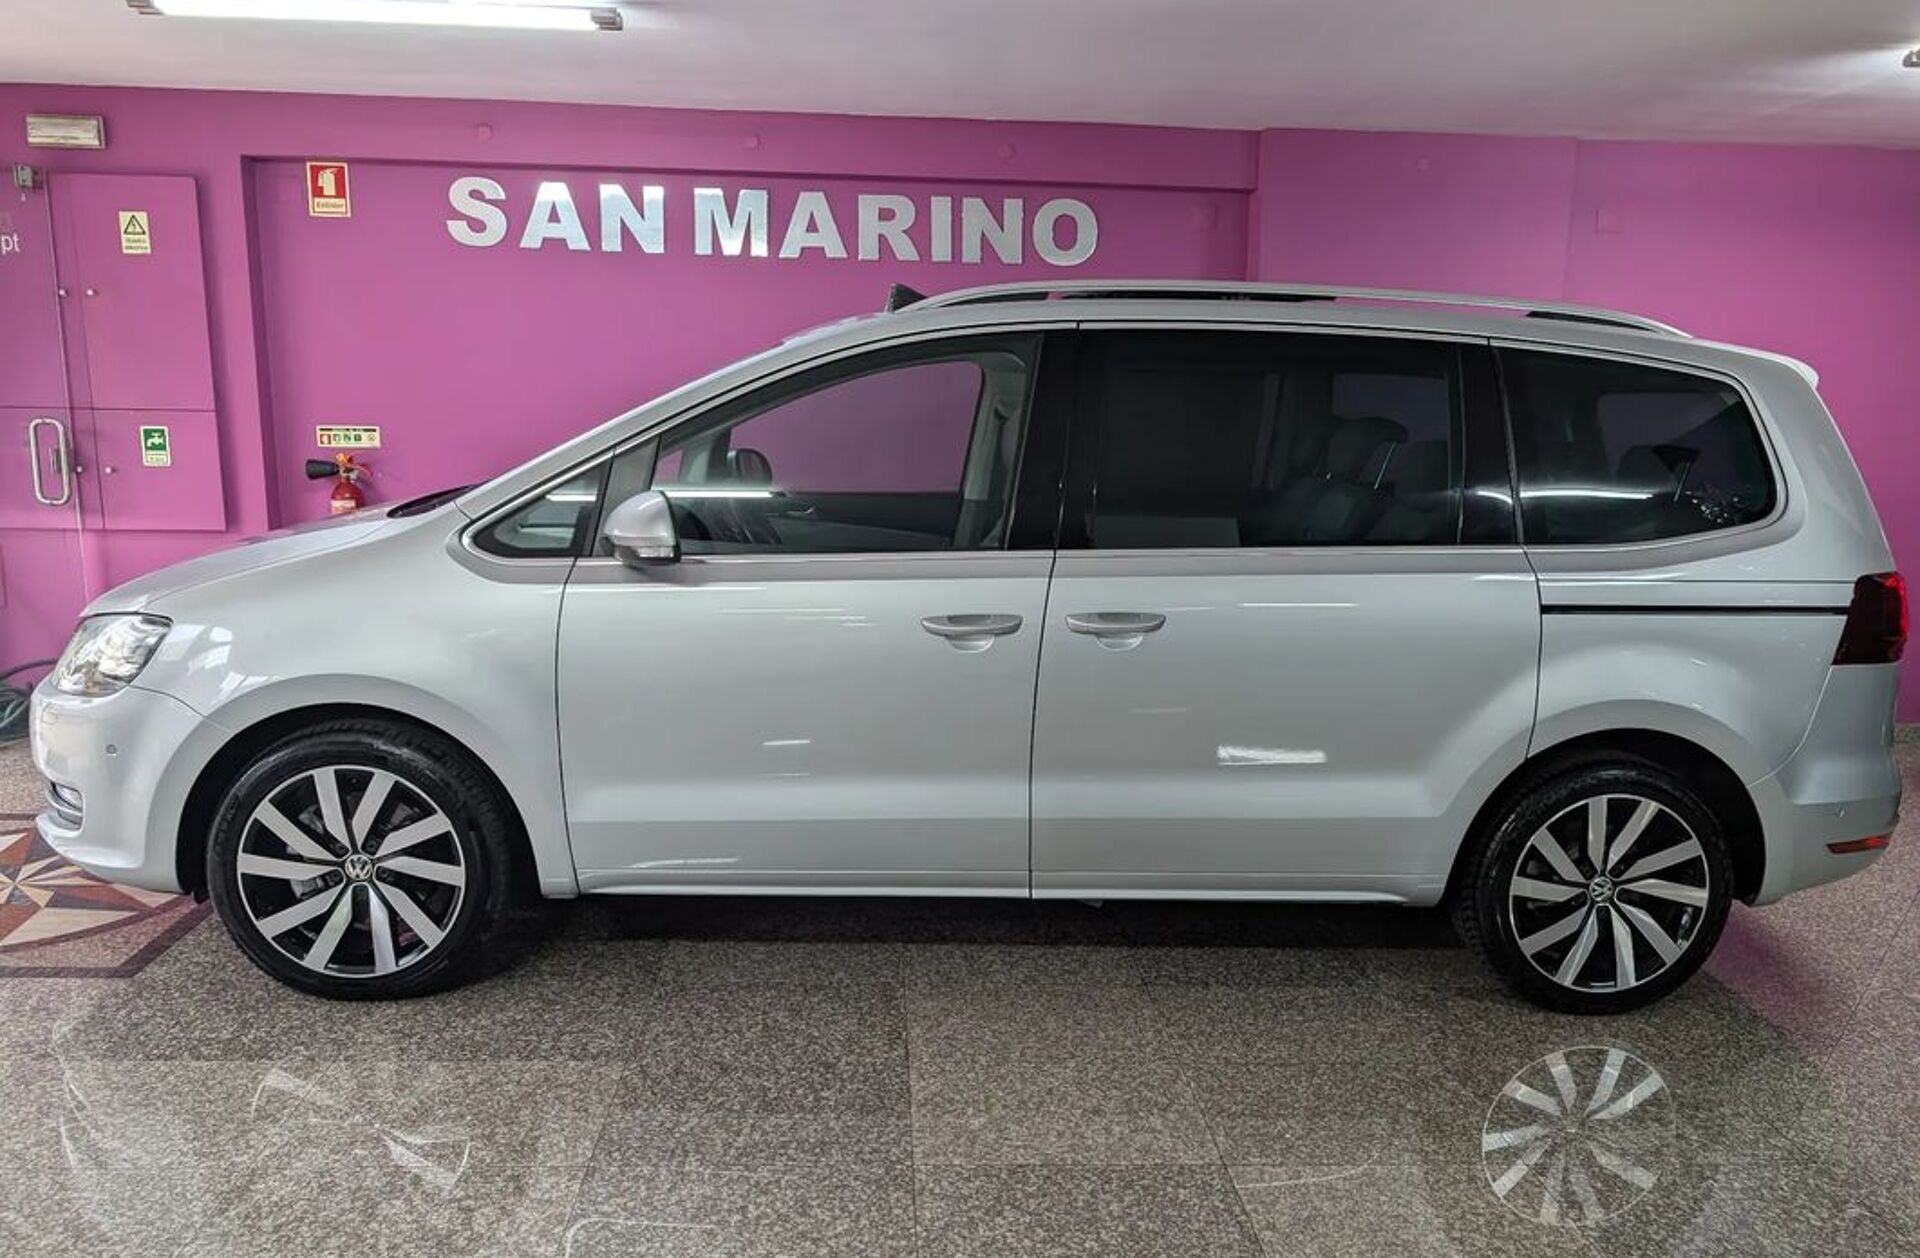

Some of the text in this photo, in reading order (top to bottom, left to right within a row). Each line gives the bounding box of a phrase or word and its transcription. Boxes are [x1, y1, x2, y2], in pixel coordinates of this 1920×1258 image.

[447, 177, 1098, 266] SAN MARINO
[345, 855, 372, 880] VW
